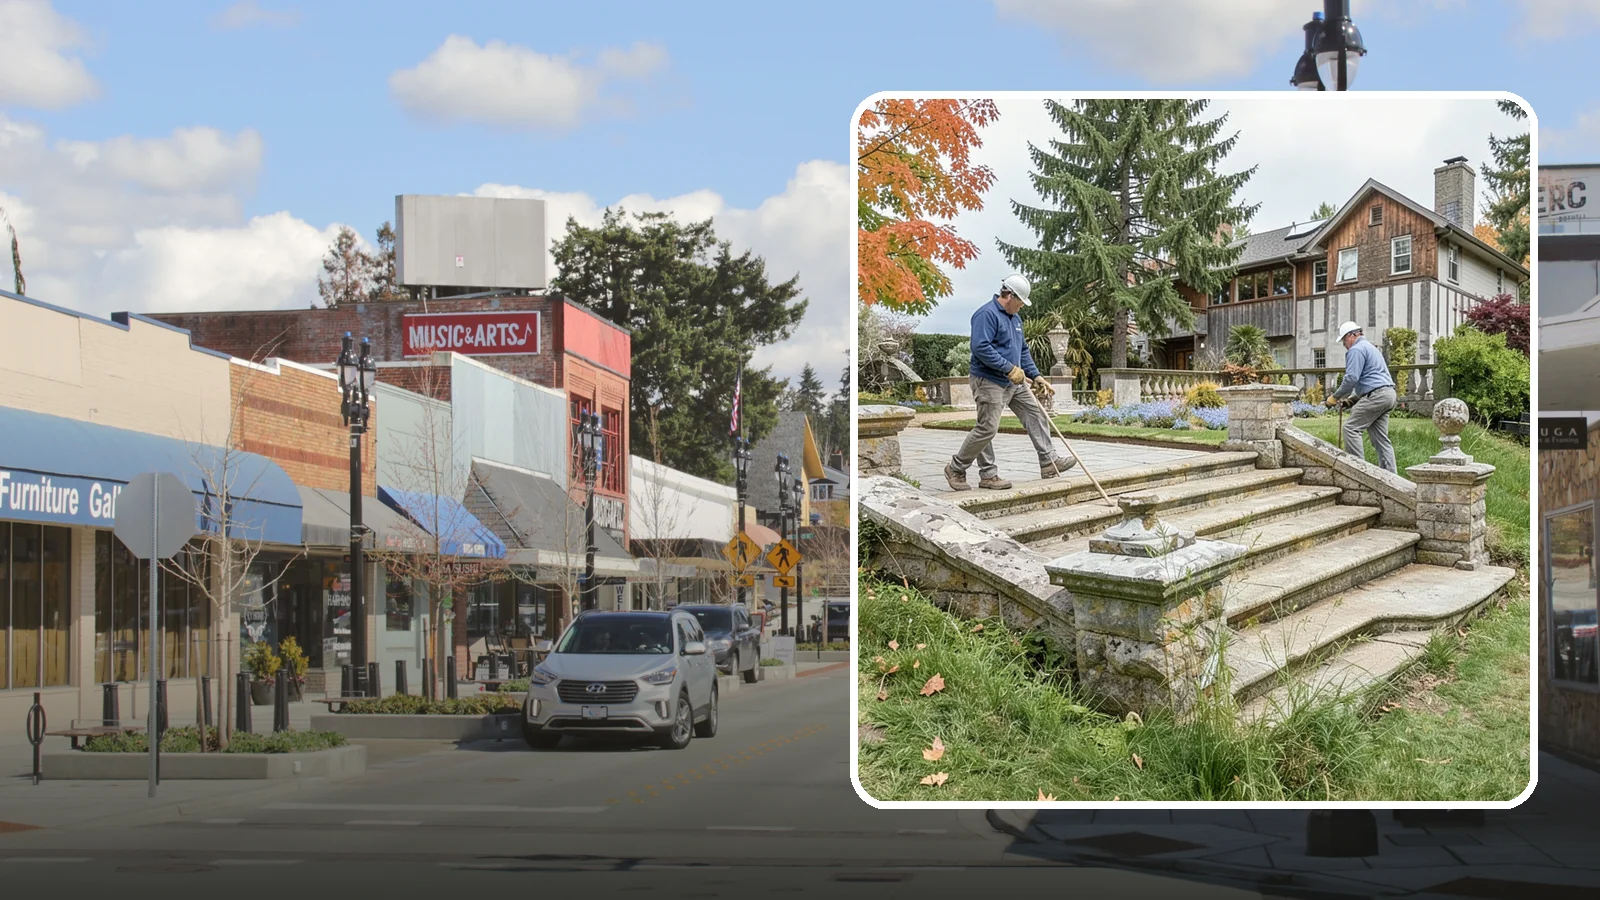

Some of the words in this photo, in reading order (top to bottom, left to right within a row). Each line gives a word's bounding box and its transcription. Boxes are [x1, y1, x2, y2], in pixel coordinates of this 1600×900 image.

[409, 323, 519, 349] MUSIC&ARTS
[1541, 427, 1577, 437] UGA
[0, 471, 79, 515] Furniture
[90, 482, 121, 519] Gal
[453, 563, 479, 574] SUSHI
